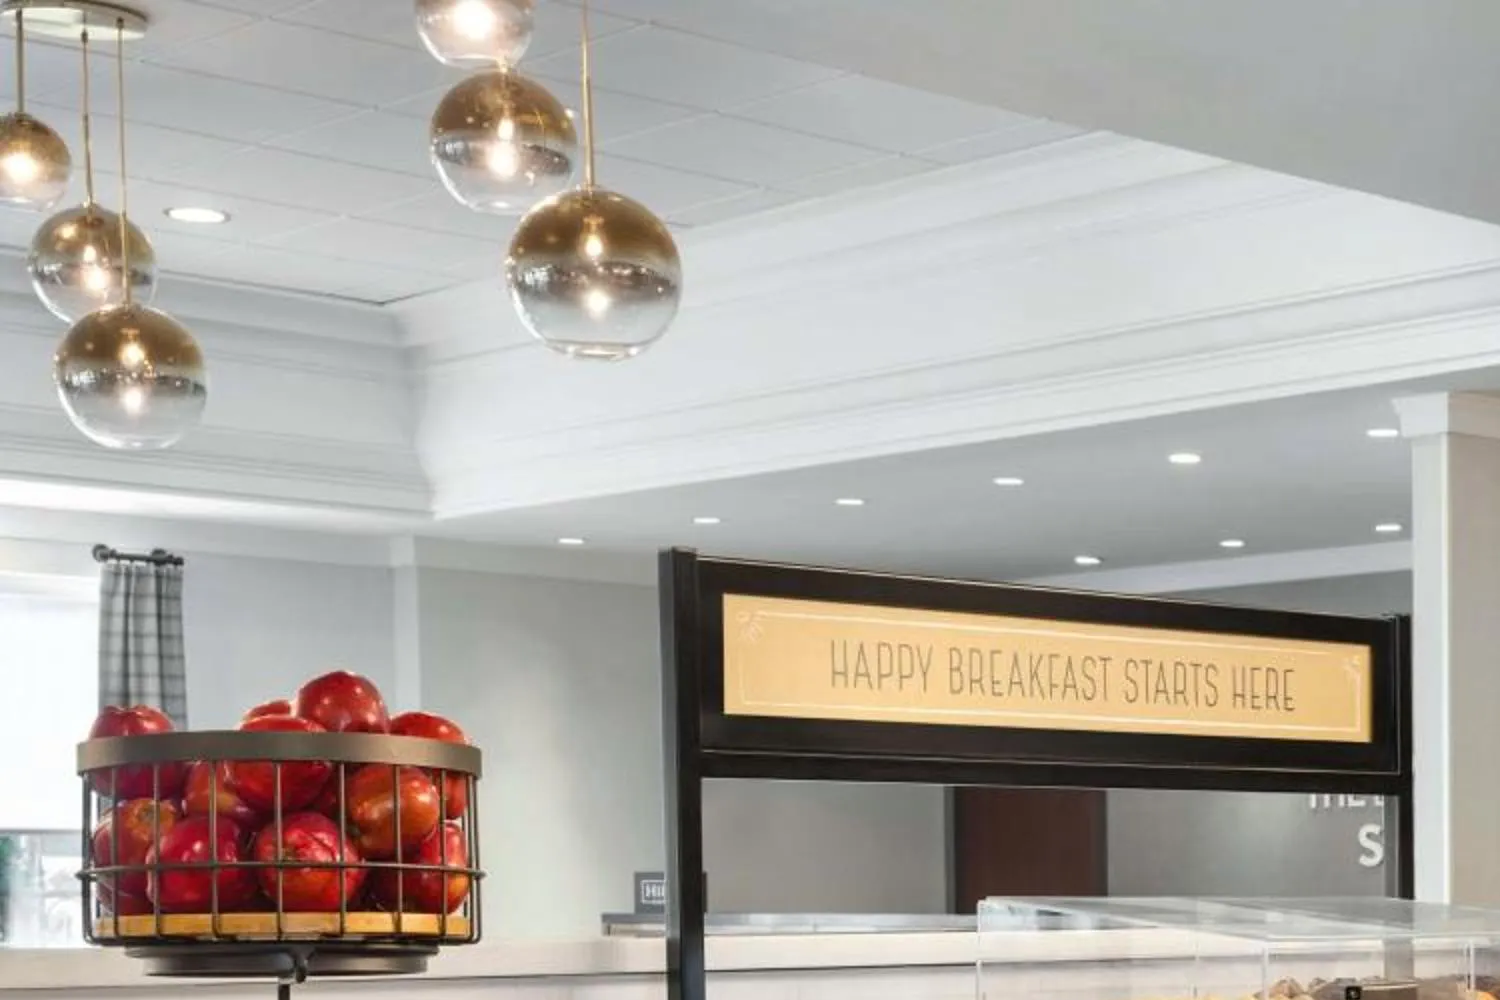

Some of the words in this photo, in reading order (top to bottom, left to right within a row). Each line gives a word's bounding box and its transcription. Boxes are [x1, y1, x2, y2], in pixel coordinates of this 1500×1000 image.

[830, 639, 934, 695] HAPPY
[948, 646, 1113, 702] BREAKFAST
[1123, 657, 1219, 708] STARTS
[1231, 665, 1296, 712] HERE
